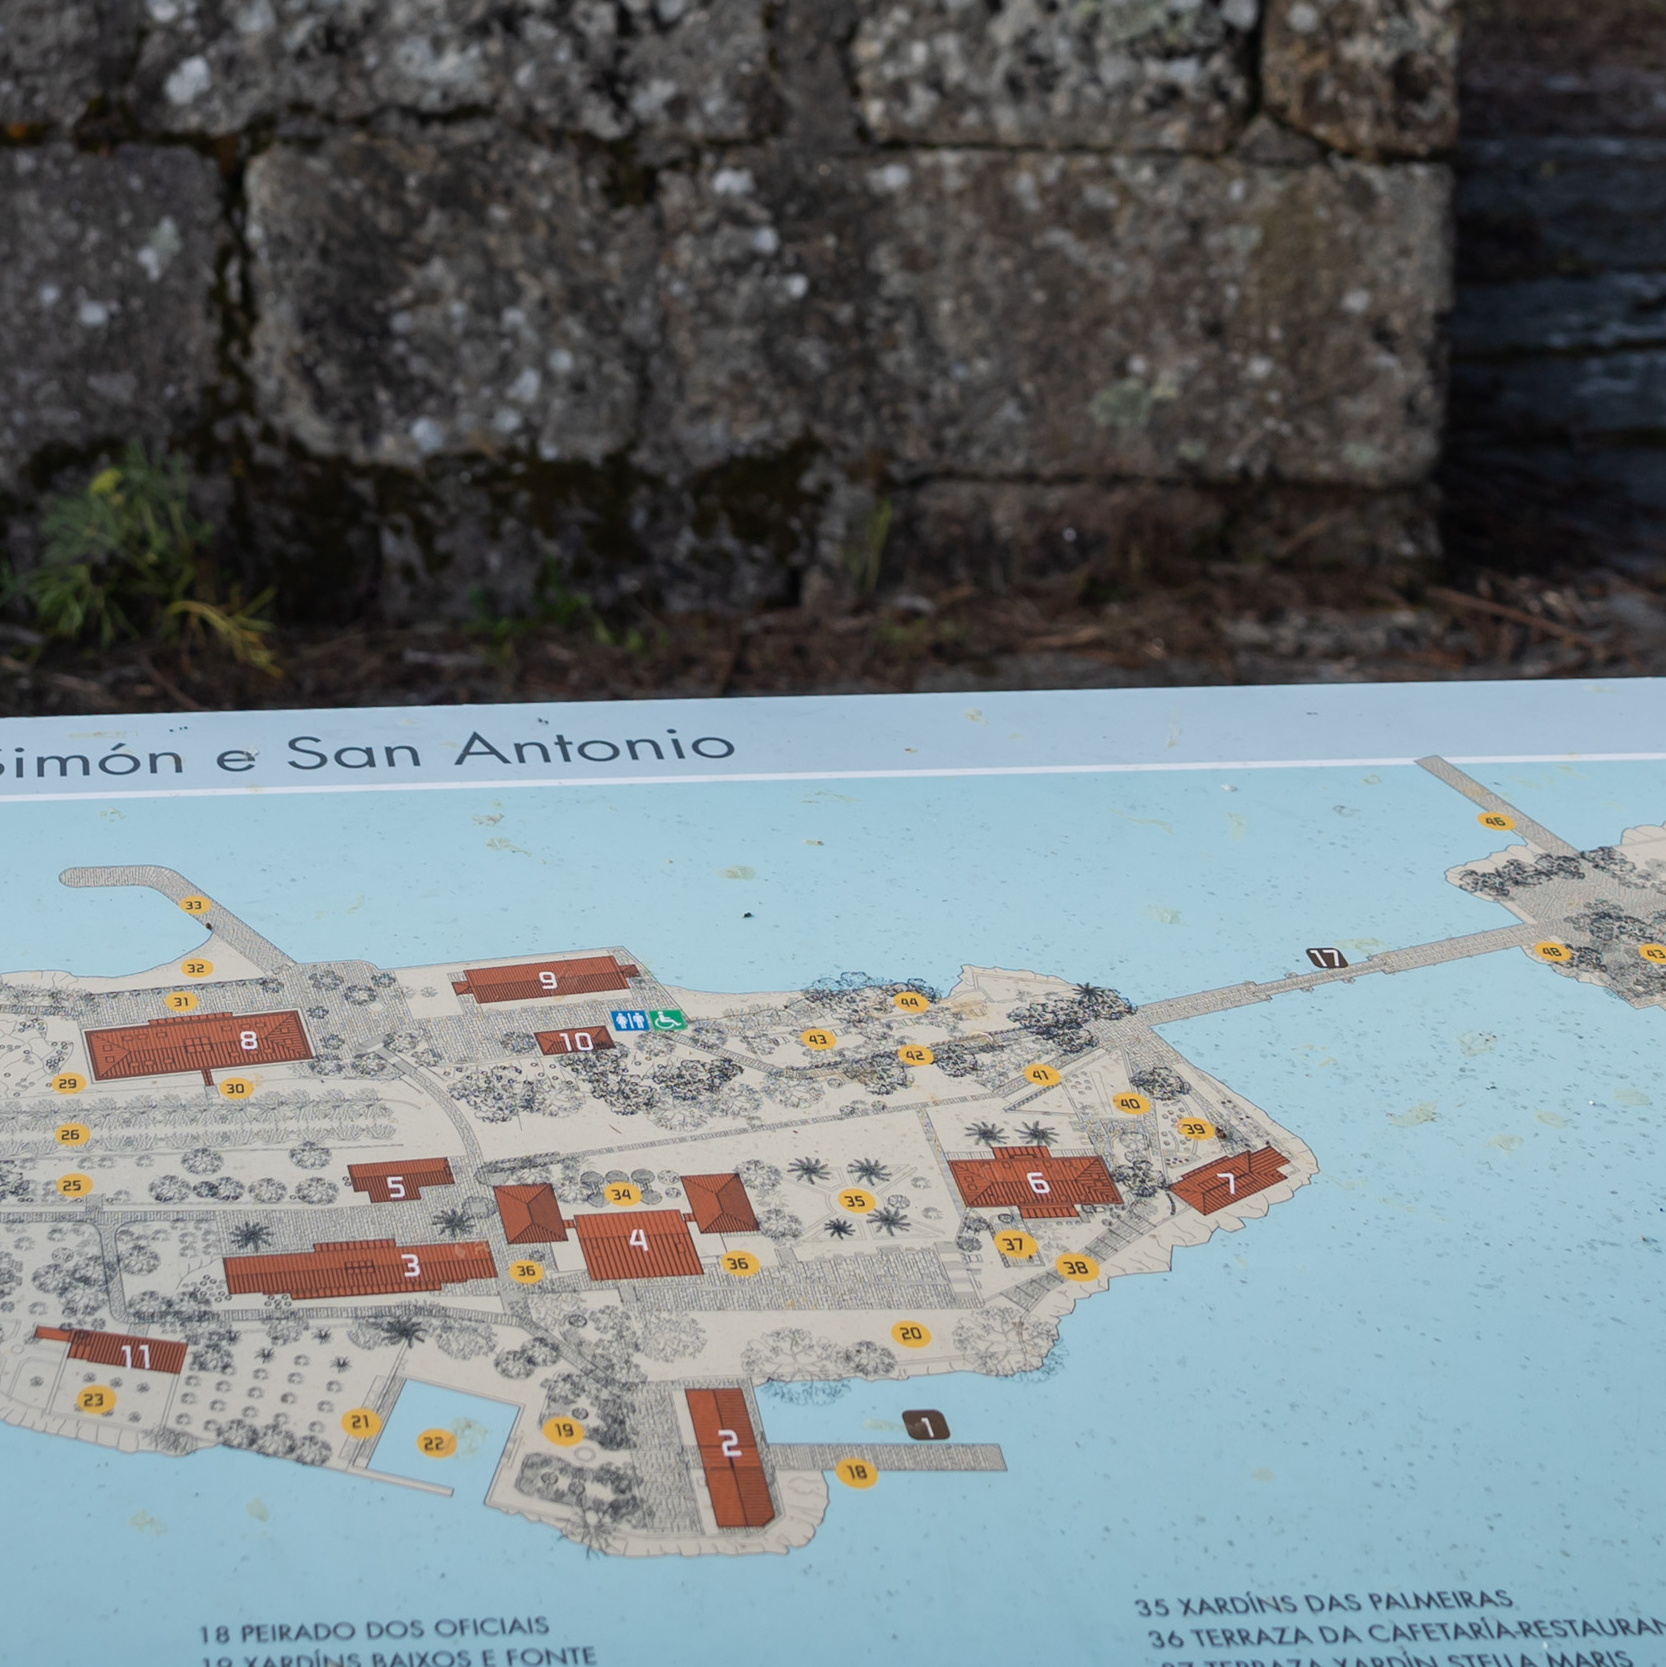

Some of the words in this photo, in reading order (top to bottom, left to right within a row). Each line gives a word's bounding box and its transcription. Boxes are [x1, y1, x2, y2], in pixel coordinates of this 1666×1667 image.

[217, 749, 255, 772] e
[287, 735, 421, 771] San
[454, 728, 735, 766] Antonio
[1485, 817, 1507, 827] 46
[186, 901, 202, 911] 33
[1309, 949, 1340, 967] 17
[1542, 947, 1562, 957] 48
[1646, 949, 1666, 959] 43
[187, 963, 204, 974] 32
[539, 971, 557, 989] 9
[174, 997, 189, 1007] 31
[900, 997, 919, 1008] 44
[240, 1031, 257, 1050] 8
[559, 1032, 593, 1051] 10
[808, 1034, 828, 1045] 43
[906, 1049, 925, 1061] 42
[1032, 1070, 1049, 1081] 41
[58, 1078, 77, 1089] 29
[226, 1083, 244, 1094] 30
[1120, 1098, 1140, 1109] 40
[60, 1129, 79, 1141] 26
[1183, 1124, 1206, 1135] 39
[62, 1180, 81, 1191] 25
[387, 1176, 405, 1198] 5
[1027, 1172, 1050, 1194] 6
[1217, 1174, 1236, 1194] 7
[611, 1188, 632, 1201] 34
[844, 1195, 865, 1208] 35
[630, 1228, 649, 1252] 4
[1001, 1238, 1023, 1251] 37
[401, 1254, 421, 1277] 3
[727, 1257, 749, 1271] 36
[1063, 1262, 1089, 1274] 38
[516, 1265, 536, 1277] 36
[899, 1327, 922, 1341] 20
[121, 1344, 150, 1369] 11
[83, 1393, 104, 1407] 23
[351, 1415, 370, 1428] 21
[921, 1417, 935, 1438] 1
[555, 1423, 575, 1438] 19
[424, 1437, 444, 1450] 22
[718, 1429, 742, 1457] 2
[846, 1466, 867, 1479] 18
[1135, 1598, 1169, 1617] 35
[1178, 1591, 1298, 1616] XARDÍNS
[1305, 1594, 1362, 1613] DAS
[1369, 1590, 1513, 1610] PALMEIRAS
[200, 1625, 230, 1644] 18
[241, 1622, 355, 1643] PEIRADO
[366, 1619, 424, 1640] DOS
[435, 1616, 550, 1638] OFICIAIS
[1148, 1630, 1184, 1648] 36
[1190, 1627, 1313, 1647] TERRAZA
[1319, 1625, 1362, 1644] DA
[507, 1646, 597, 1667] FONTE
[1546, 1650, 1633, 1667] MARIS
